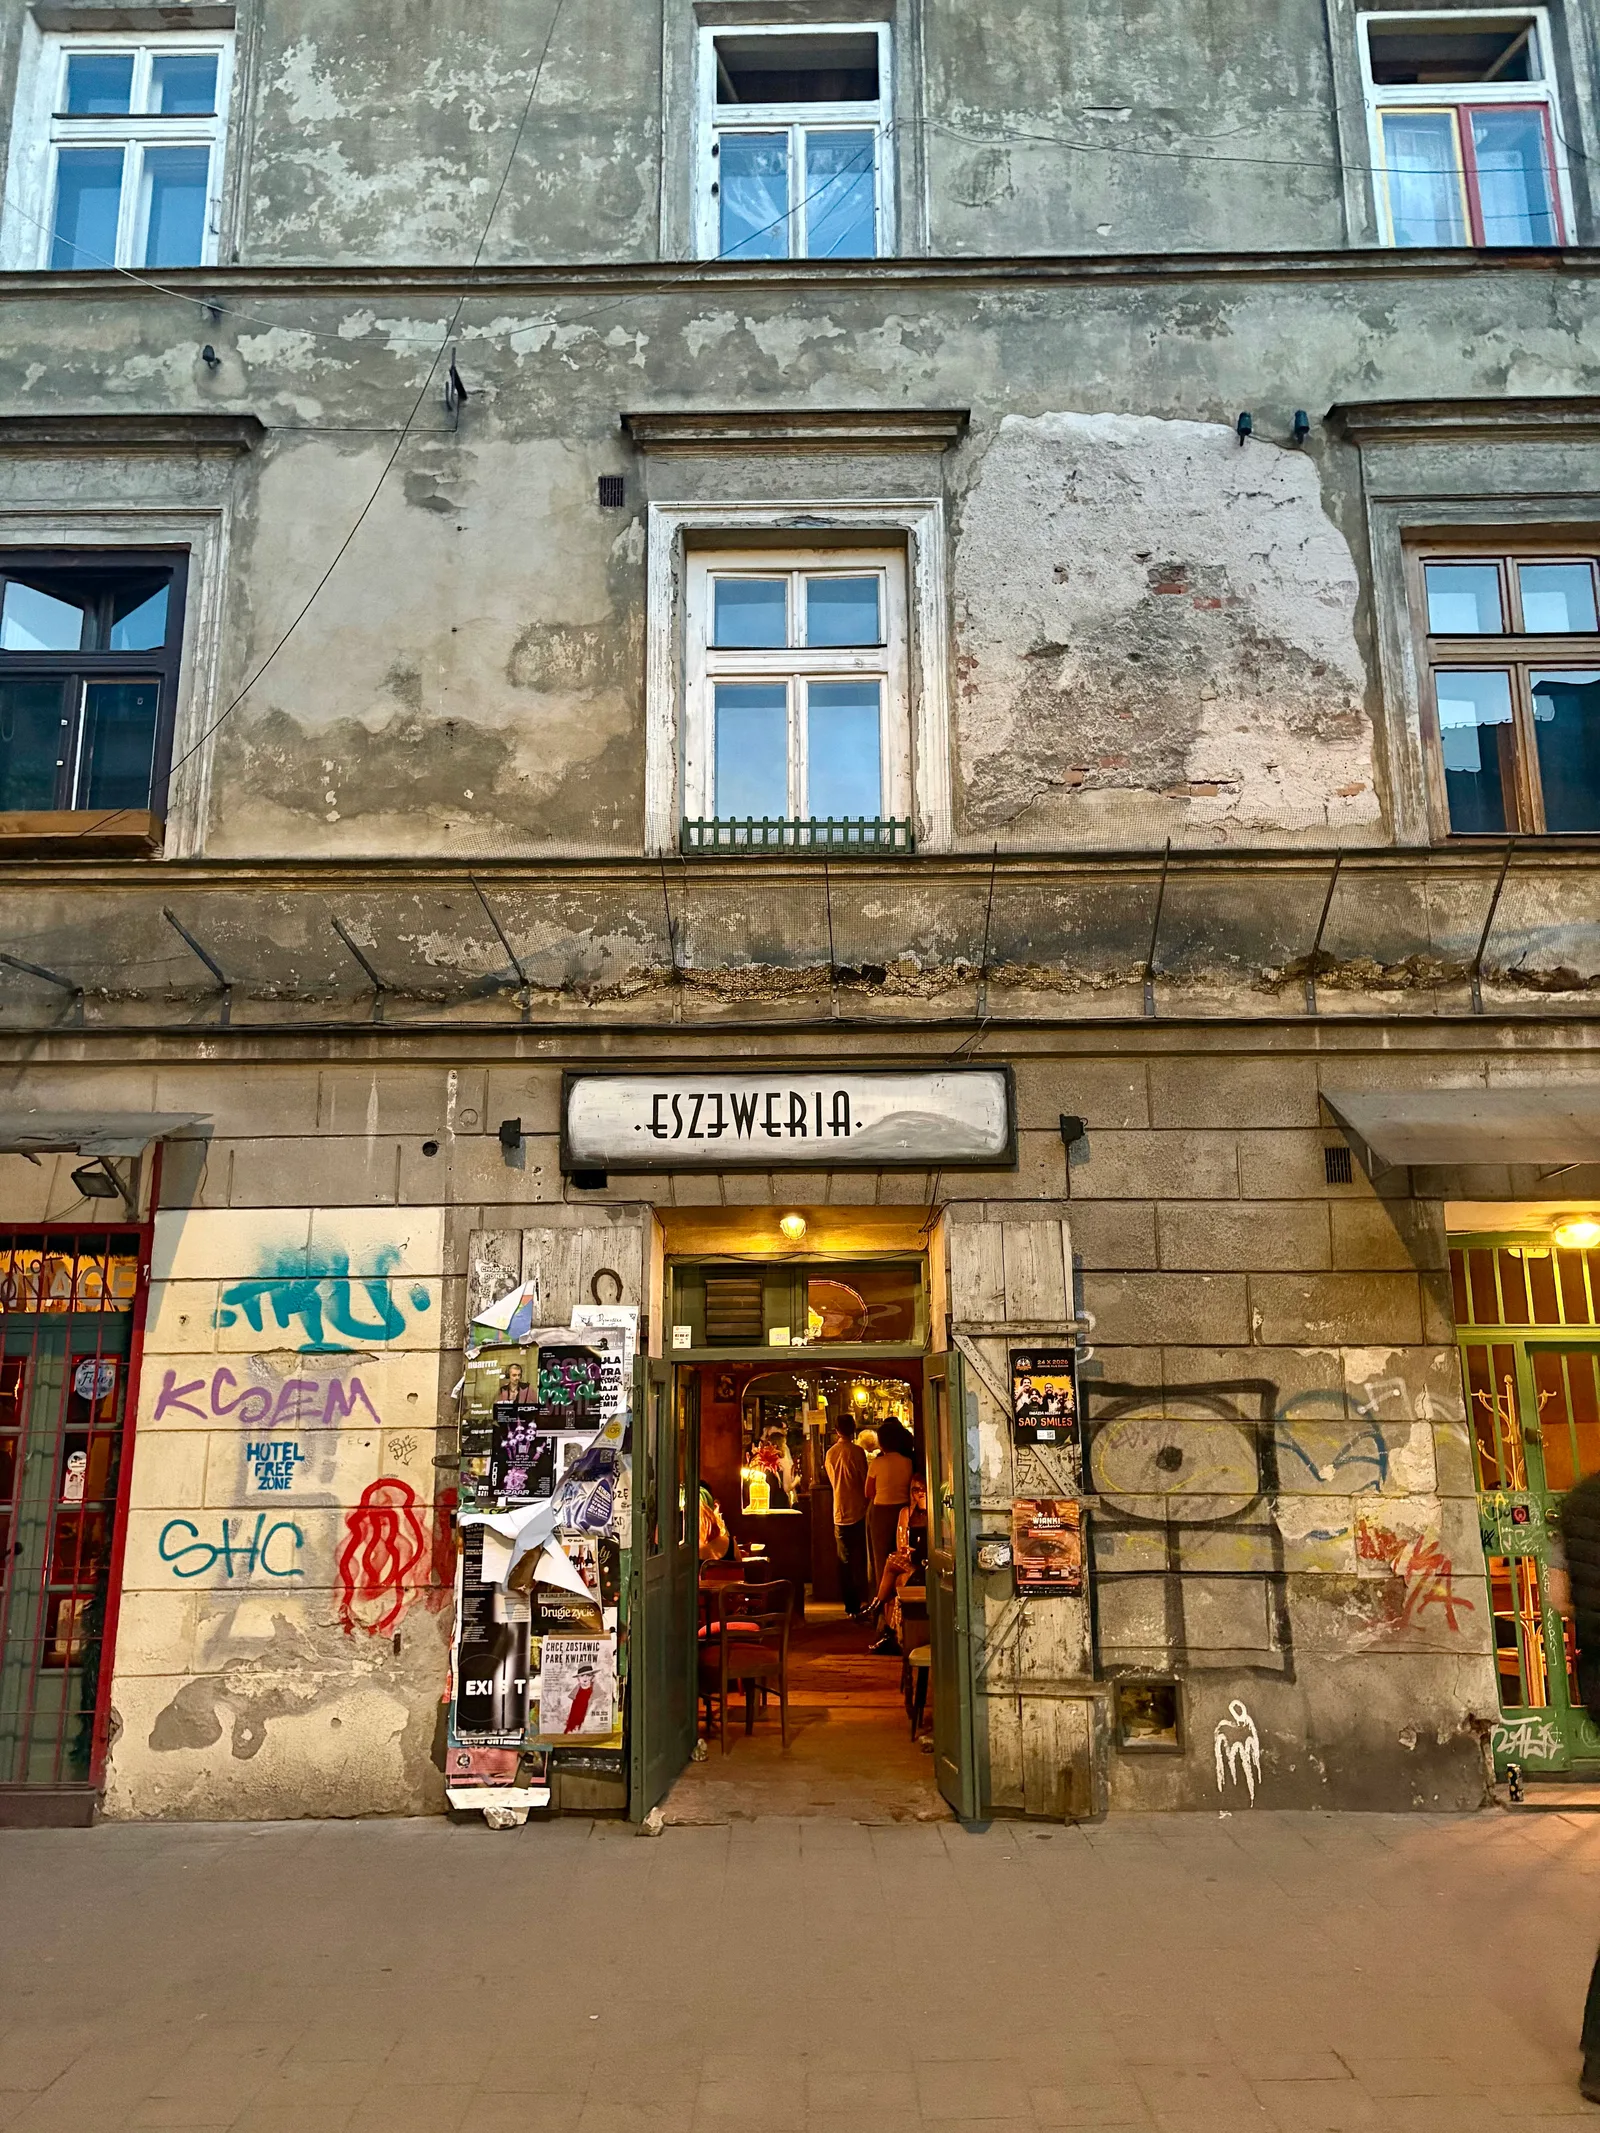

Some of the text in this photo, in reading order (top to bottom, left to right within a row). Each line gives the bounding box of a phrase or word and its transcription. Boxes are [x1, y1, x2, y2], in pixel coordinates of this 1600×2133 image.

[1018, 1416, 1073, 1427] SAD SMILES
[247, 1441, 305, 1462] HOTEL
[254, 1461, 295, 1477] FREE
[257, 1476, 293, 1491] ZONE
[158, 1512, 305, 1578] SHC
[541, 1605, 571, 1620] Drugie
[545, 1641, 564, 1654] CHCĘ
[545, 1653, 563, 1666] PARĘ
